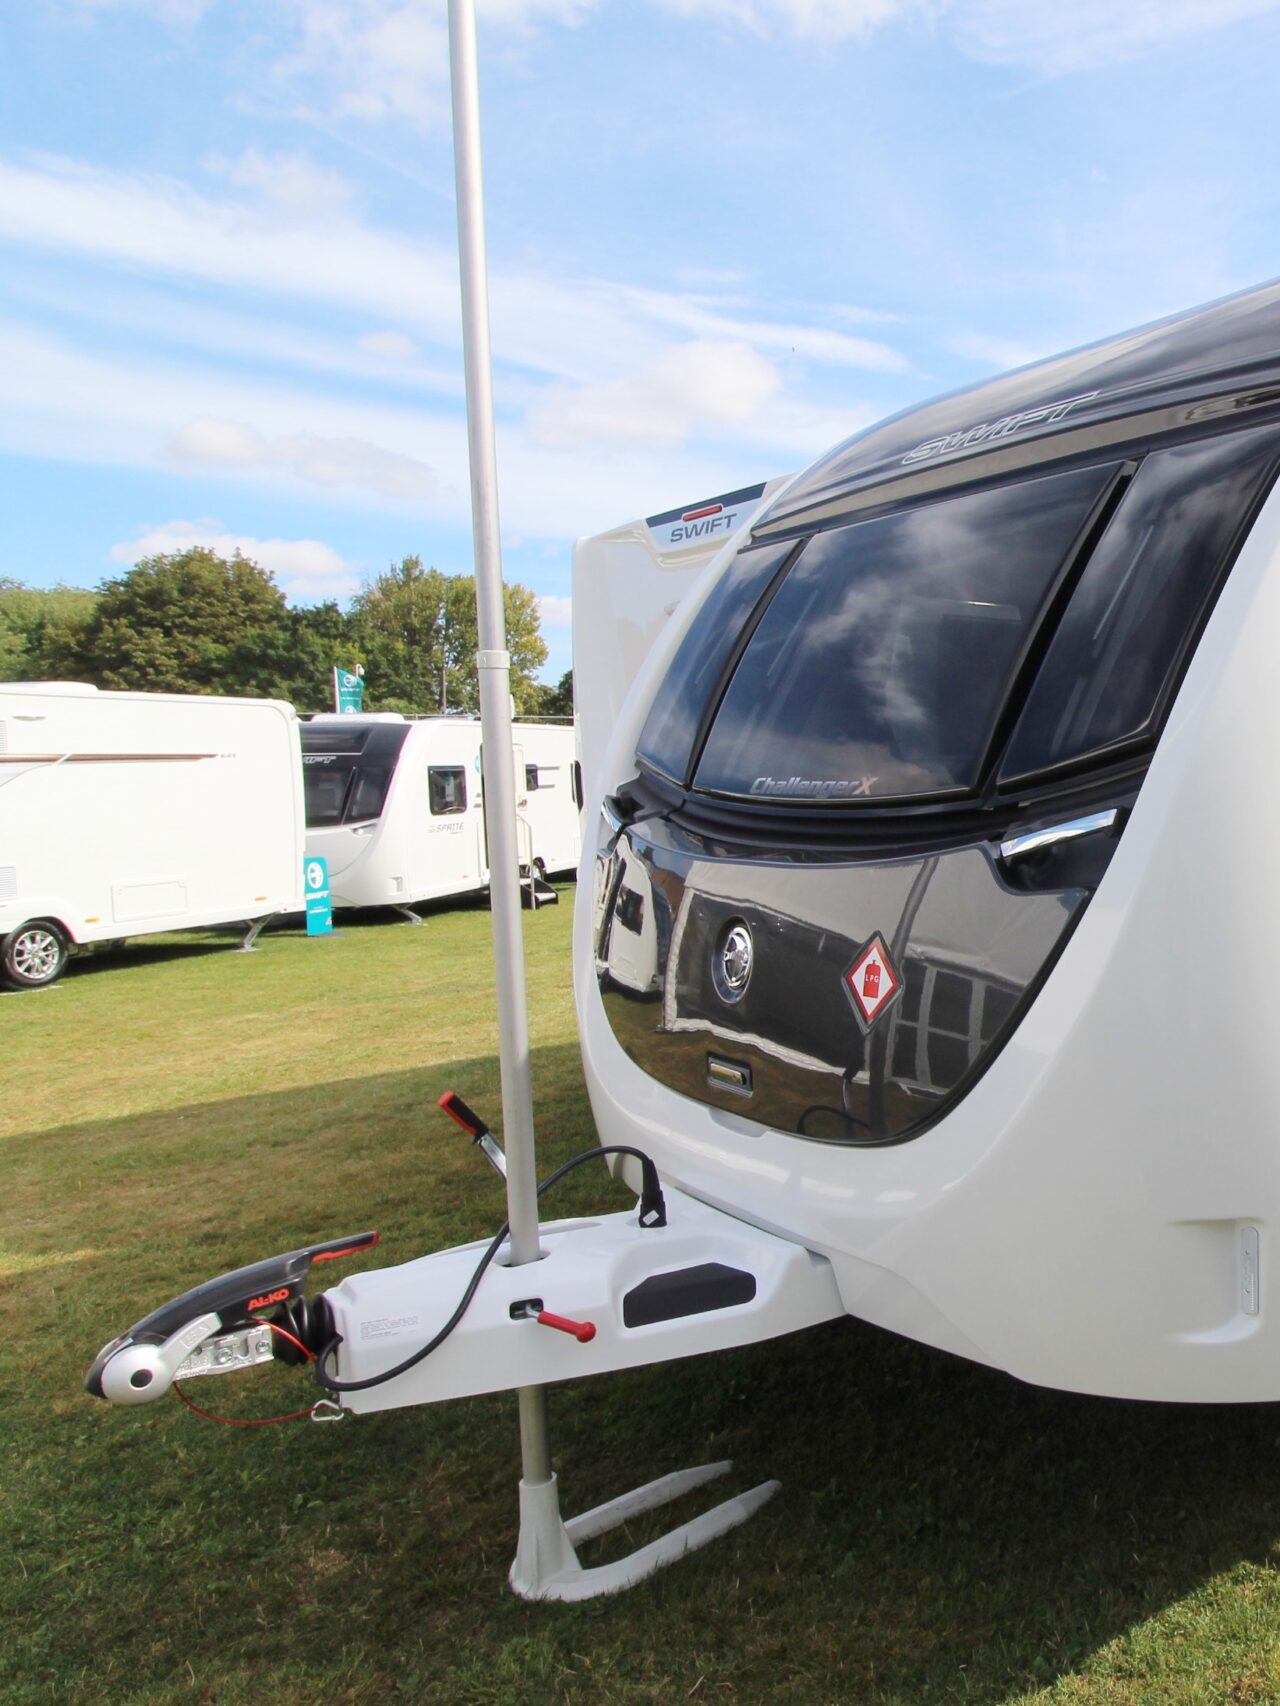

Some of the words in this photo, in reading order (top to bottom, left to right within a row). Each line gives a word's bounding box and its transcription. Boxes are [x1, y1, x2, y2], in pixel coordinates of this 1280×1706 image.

[902, 390, 1100, 465] SWIFT
[670, 513, 737, 543] SWIFT
[865, 974, 880, 983] LPG
[247, 1288, 290, 1311] AL-KO
